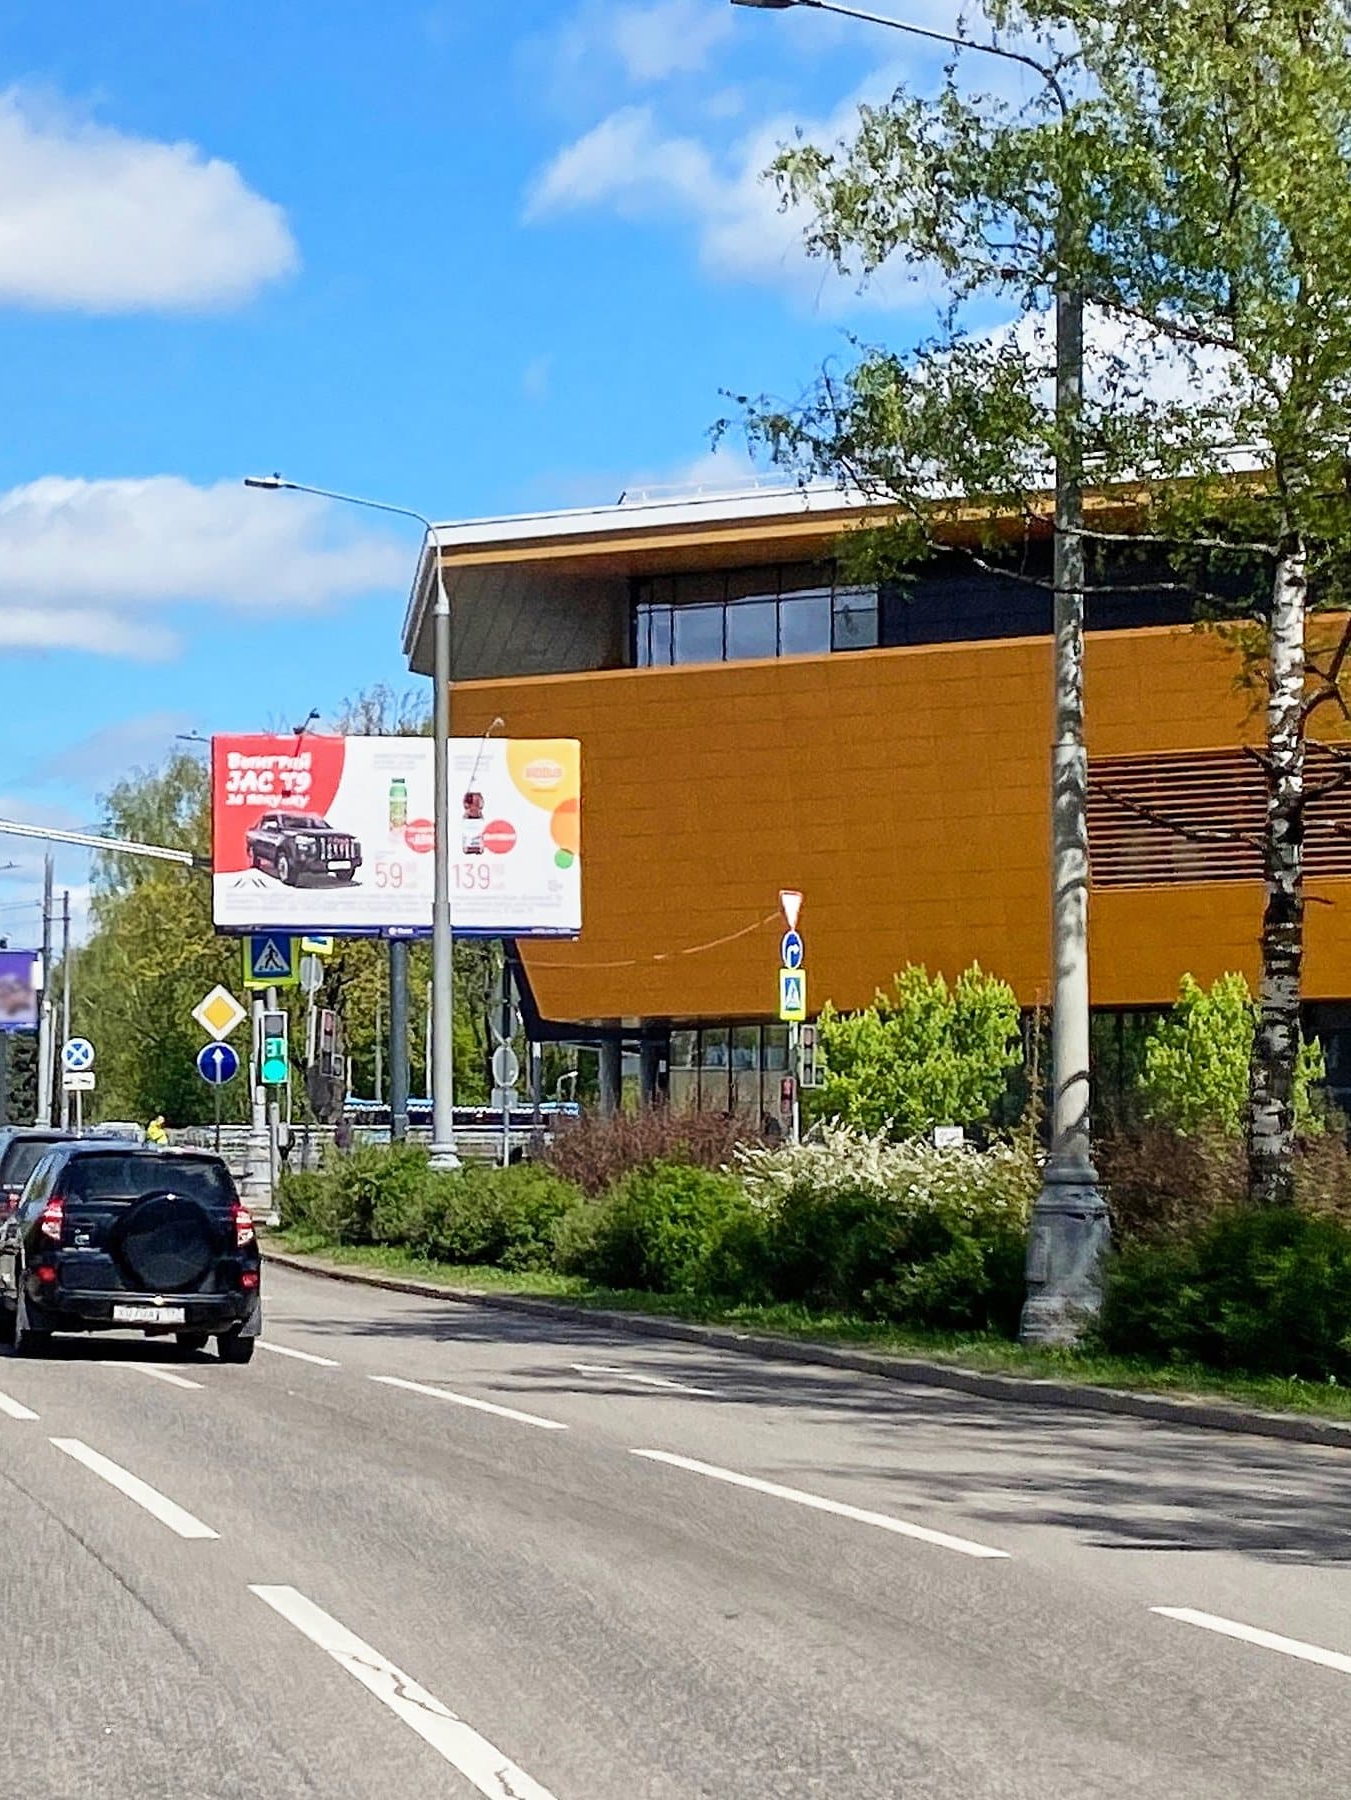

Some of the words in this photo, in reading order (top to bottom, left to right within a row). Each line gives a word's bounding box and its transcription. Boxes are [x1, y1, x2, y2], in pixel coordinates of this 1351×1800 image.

[226, 770, 275, 792] JAC
[279, 771, 312, 792] T9
[375, 862, 403, 889] 59
[453, 863, 491, 890] 139
